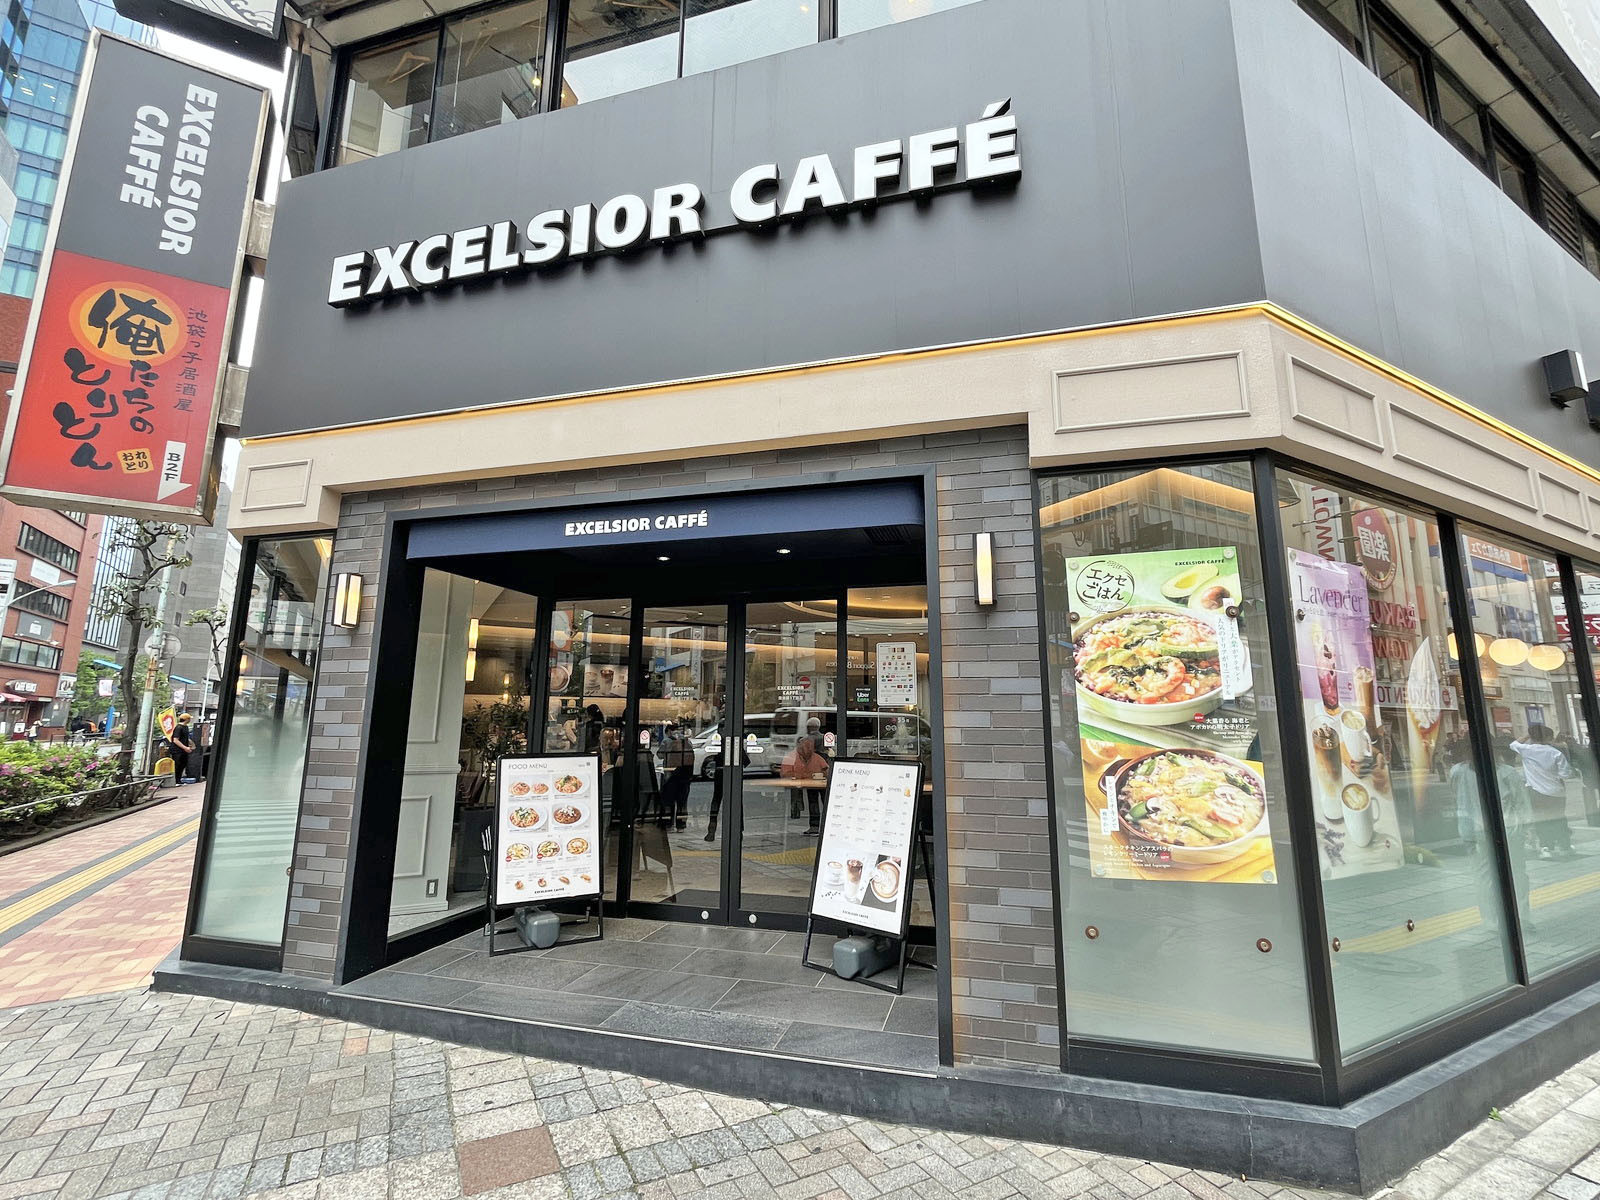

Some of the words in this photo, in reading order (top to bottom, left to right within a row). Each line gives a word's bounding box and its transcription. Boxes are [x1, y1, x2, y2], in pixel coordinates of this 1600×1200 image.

[120, 105, 169, 208] CAFFÉ
[159, 83, 218, 255] EXCELSIOR
[328, 182, 704, 306] EXCELSIOR
[730, 98, 1022, 223] CAFFÉ
[173, 307, 209, 413] 池袋っ子居酒屋
[52, 347, 120, 471] とりとん
[164, 452, 182, 482] B2F
[565, 517, 651, 536] EXCELSIOR
[655, 510, 708, 530] CAFFÉ
[1082, 582, 1125, 601] ごはん
[1086, 567, 1128, 588] エクセ
[1298, 575, 1364, 613] Lavender
